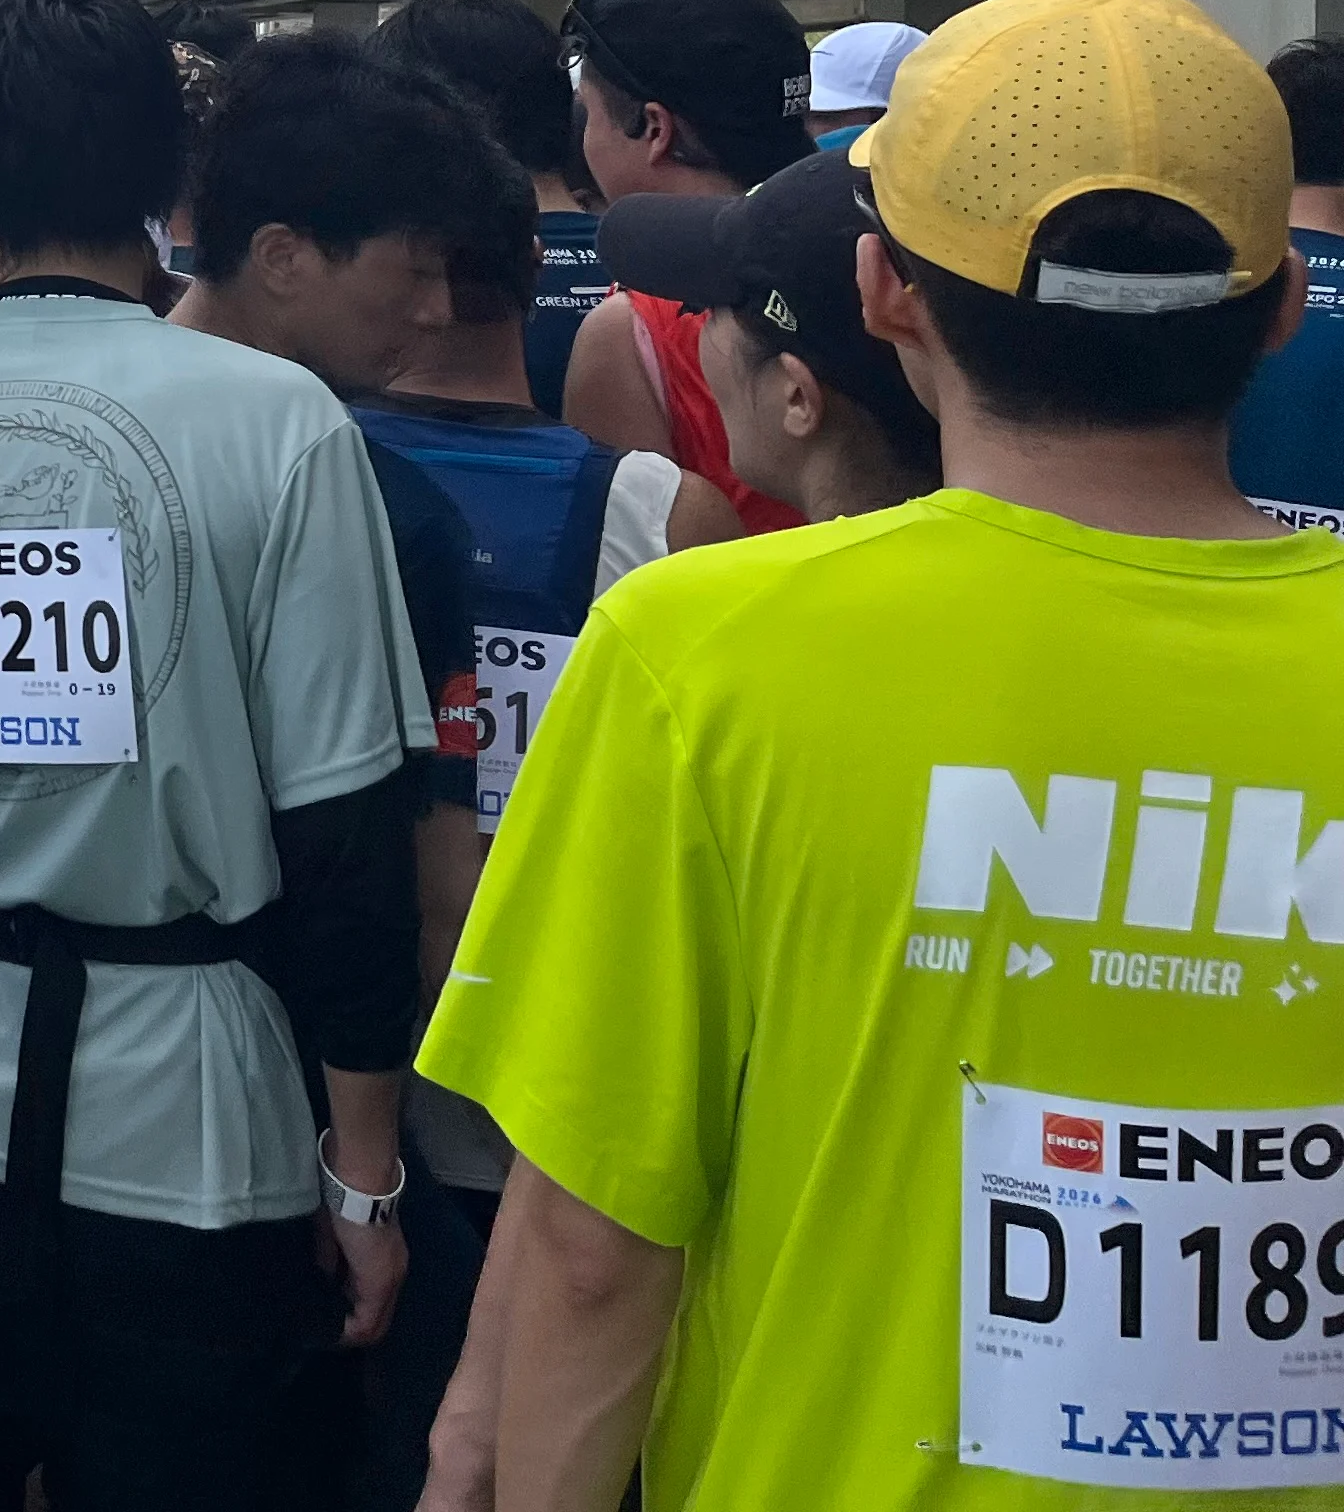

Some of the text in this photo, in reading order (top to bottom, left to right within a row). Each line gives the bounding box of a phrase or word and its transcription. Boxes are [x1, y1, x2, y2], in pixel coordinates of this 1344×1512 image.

[577, 249, 597, 259] 20
[1306, 293, 1335, 304] XPO
[1257, 505, 1344, 535] NEO
[438, 706, 478, 723] ENE
[914, 764, 1344, 945] Nik
[904, 935, 1244, 998] RUN TOGETHER
[1046, 1123, 1344, 1183] ENEOS ENEO
[981, 1171, 1051, 1195] YOKOHAMA
[981, 1185, 1102, 1205] MARATHON 2026
